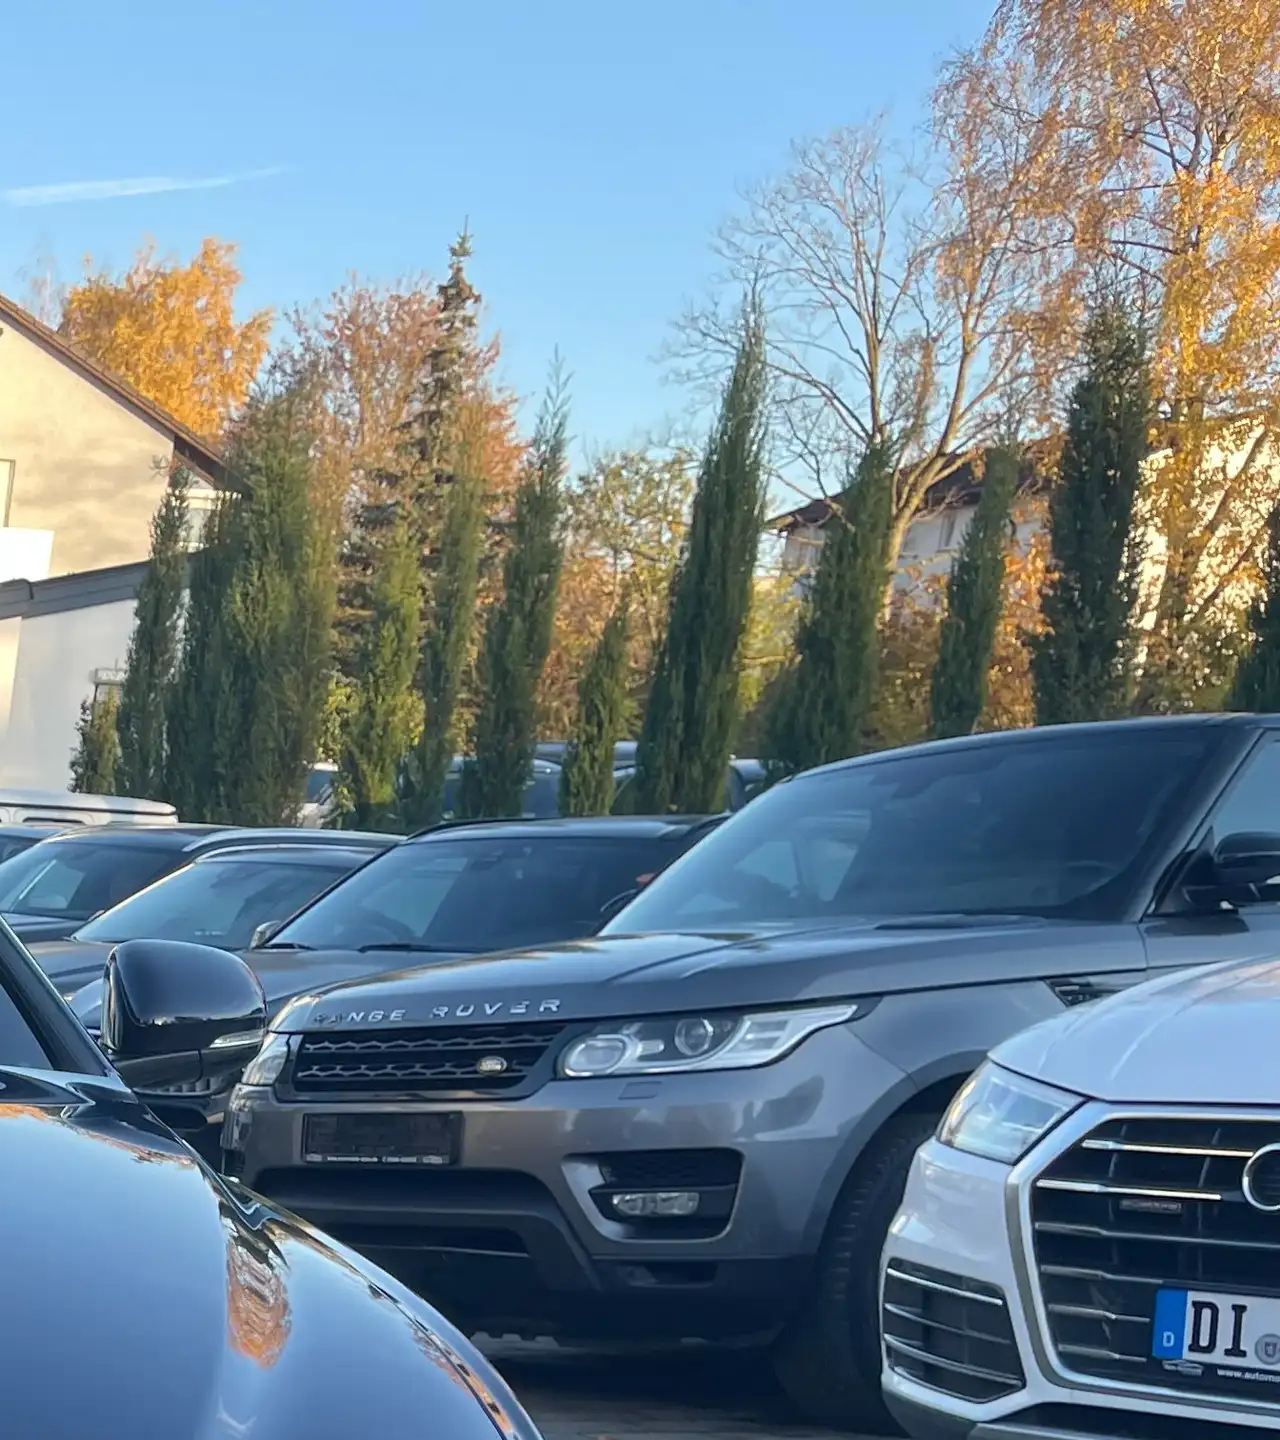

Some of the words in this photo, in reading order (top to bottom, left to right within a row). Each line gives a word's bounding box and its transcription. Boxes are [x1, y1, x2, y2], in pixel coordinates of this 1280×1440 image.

[429, 998, 562, 1020] ROVER
[1162, 1331, 1175, 1348] D
[1187, 1300, 1248, 1359] DI
